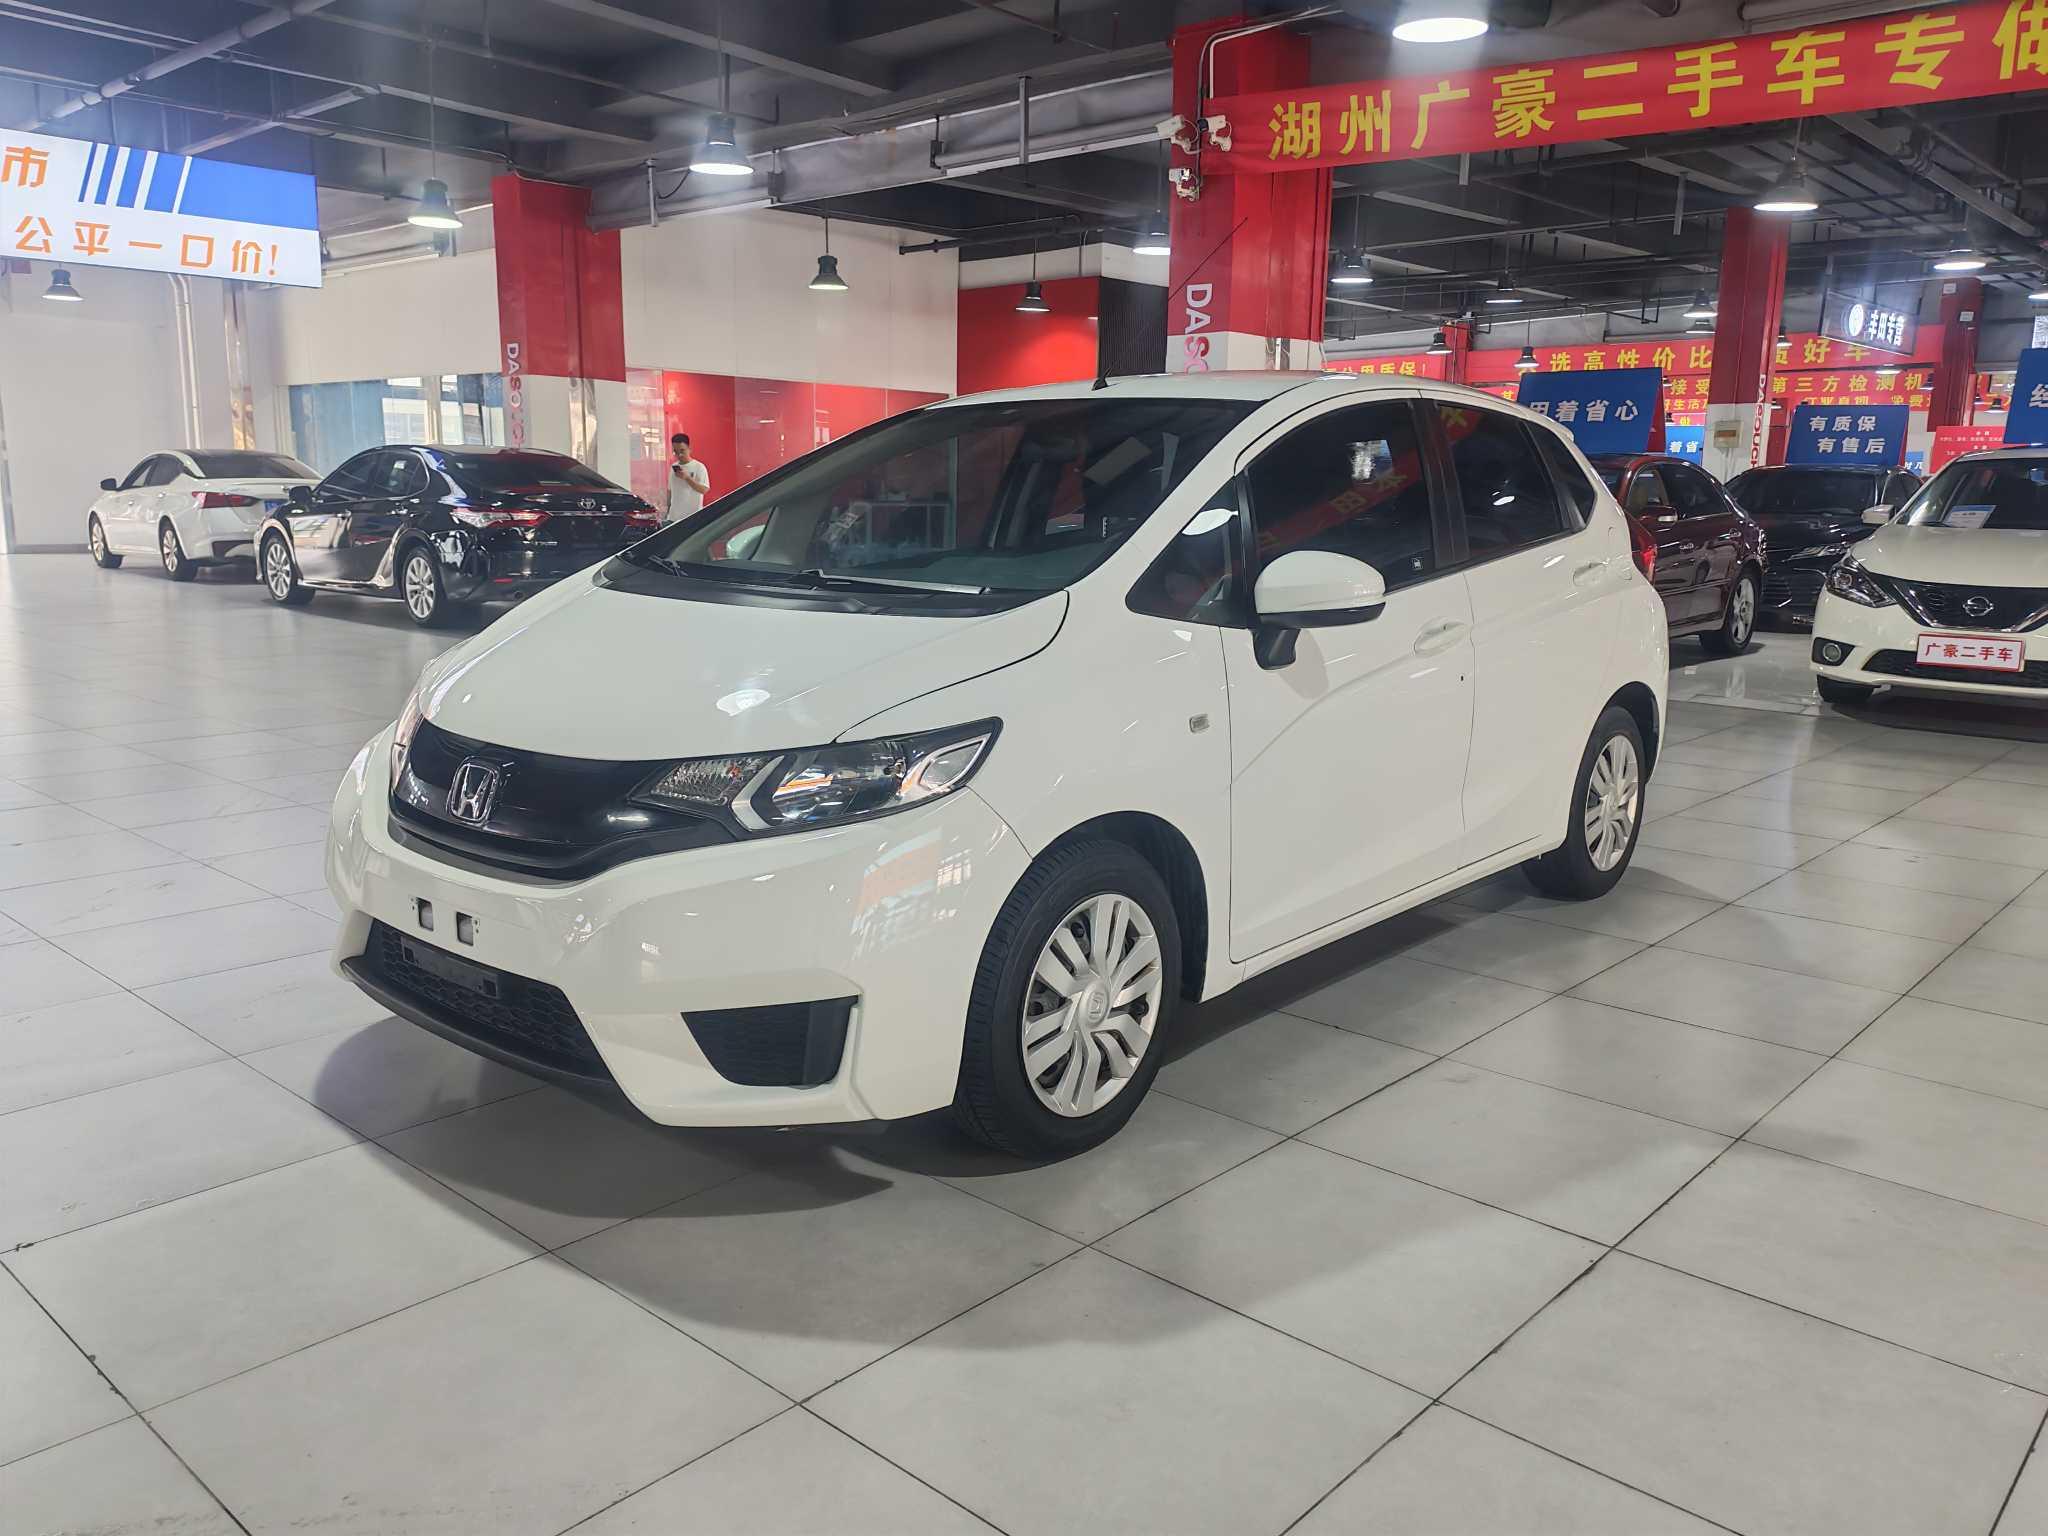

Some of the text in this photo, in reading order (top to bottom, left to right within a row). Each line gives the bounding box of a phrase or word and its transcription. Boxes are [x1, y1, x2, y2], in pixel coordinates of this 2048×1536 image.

[1808, 415, 1877, 433] 有质保
[1816, 436, 1886, 455] 有售后
[1925, 641, 2013, 662] 广豪二手车
